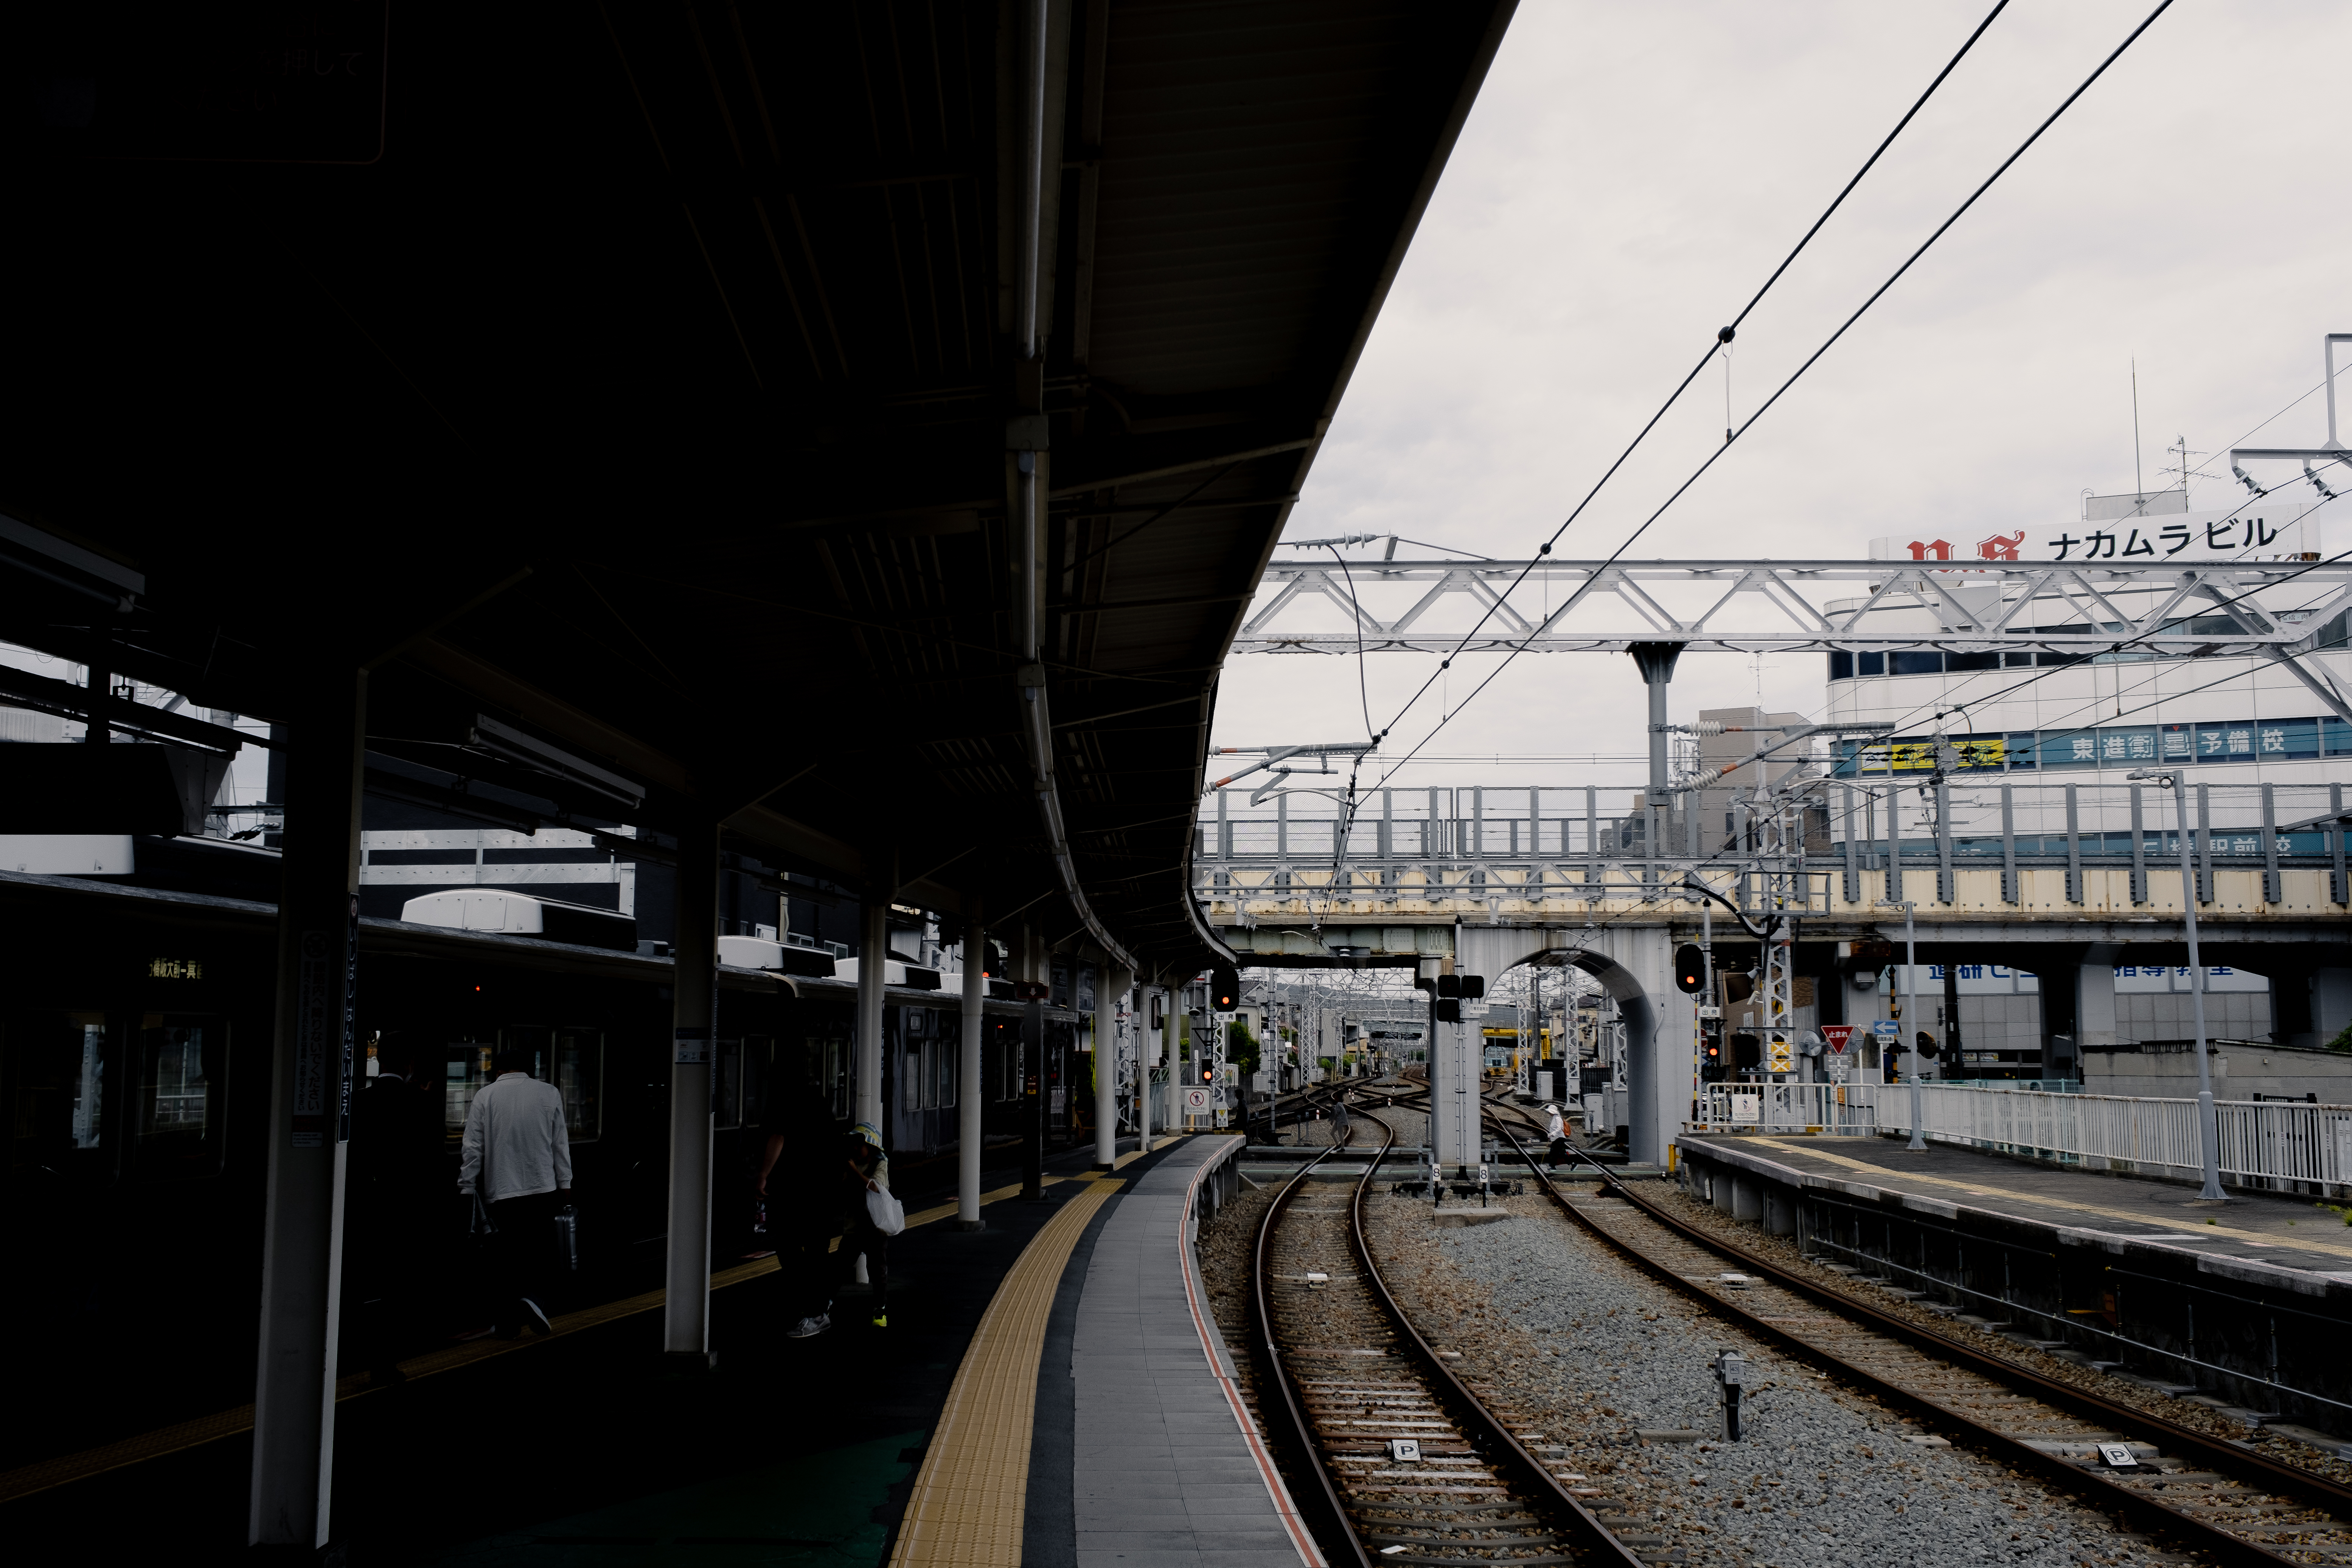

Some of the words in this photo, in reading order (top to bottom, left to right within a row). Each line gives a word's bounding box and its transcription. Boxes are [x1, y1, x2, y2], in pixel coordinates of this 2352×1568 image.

[2048, 517, 2277, 560] ナカムラビル
[2072, 729, 2285, 760] 東進衛星予備校
[1433, 1168, 1440, 1177] 8
[1480, 1169, 1487, 1179] 8
[1400, 1446, 1414, 1455] P
[2109, 1450, 2125, 1461] P
